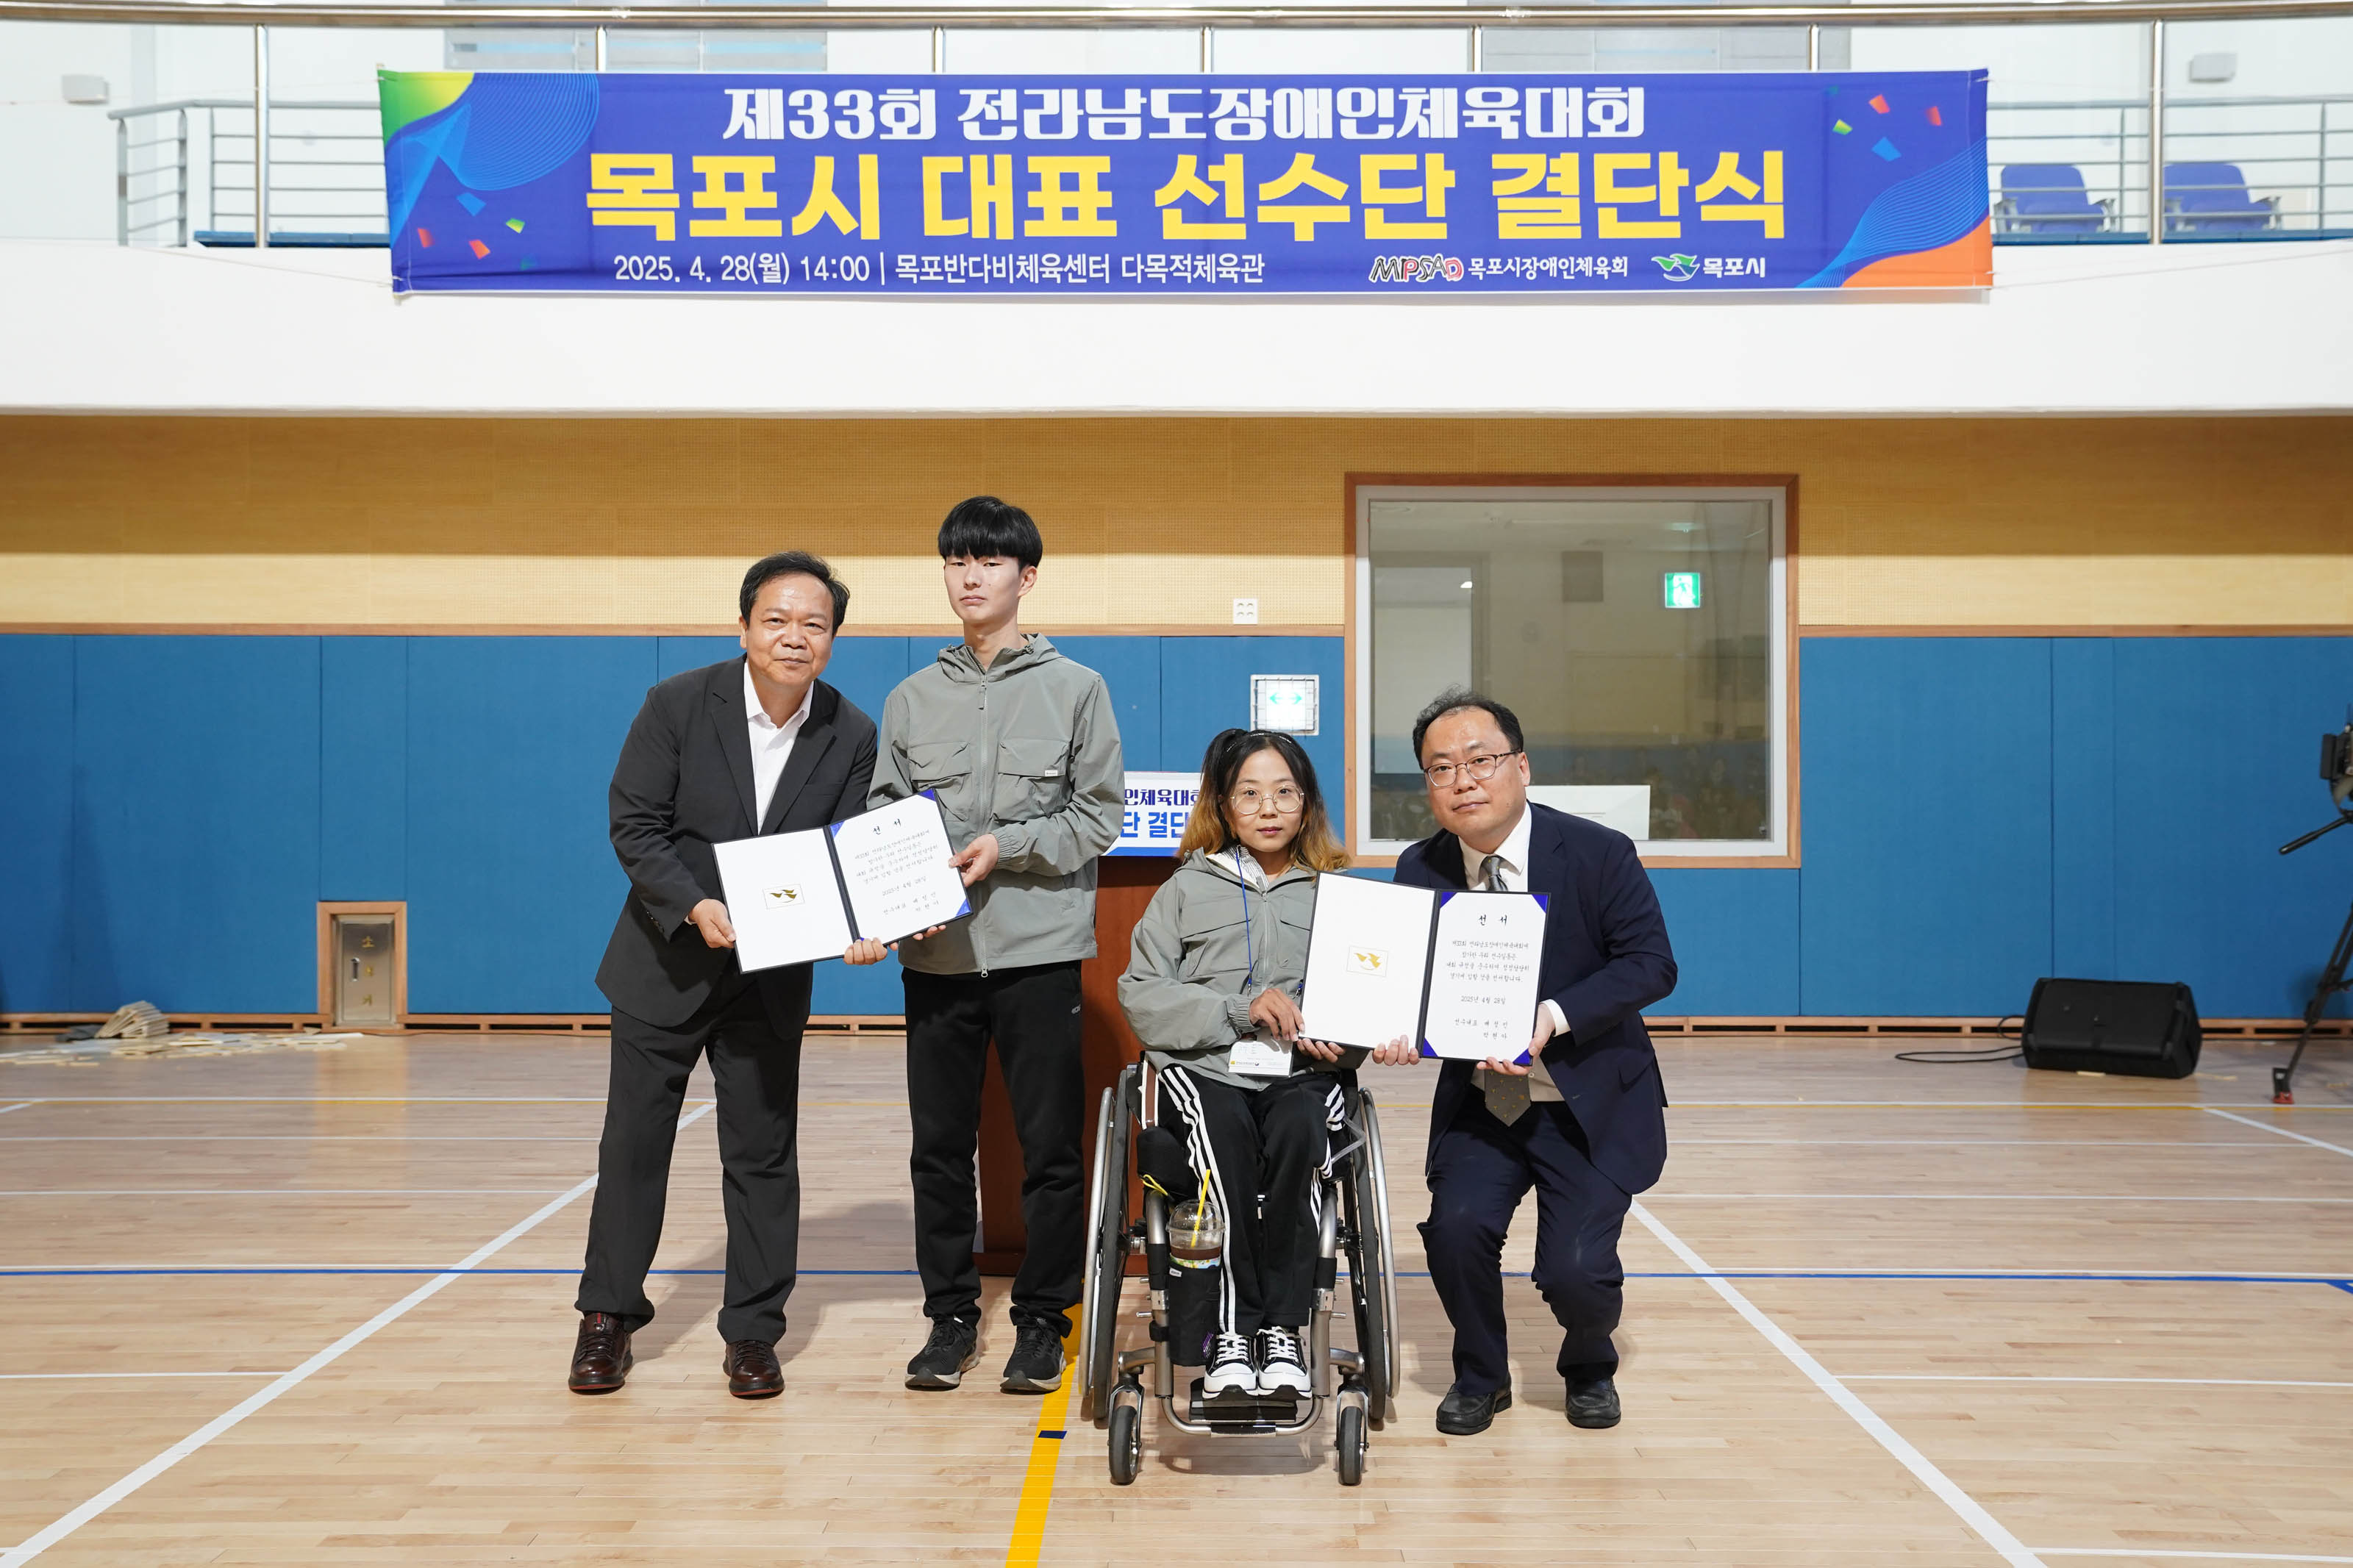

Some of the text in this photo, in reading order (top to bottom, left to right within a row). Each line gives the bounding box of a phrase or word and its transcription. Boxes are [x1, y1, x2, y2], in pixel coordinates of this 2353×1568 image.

[723, 87, 1645, 140] 제33회 전라남도장애인체육대회
[586, 151, 1785, 241] 목포시 대표 선수단 결단식
[614, 252, 1265, 284] 2025. 4. 28(월) 14:00 목포반다비체육센터 다목적체육관
[1468, 256, 1629, 281] 목포시장애인체육회
[1703, 257, 1766, 279] 목포시
